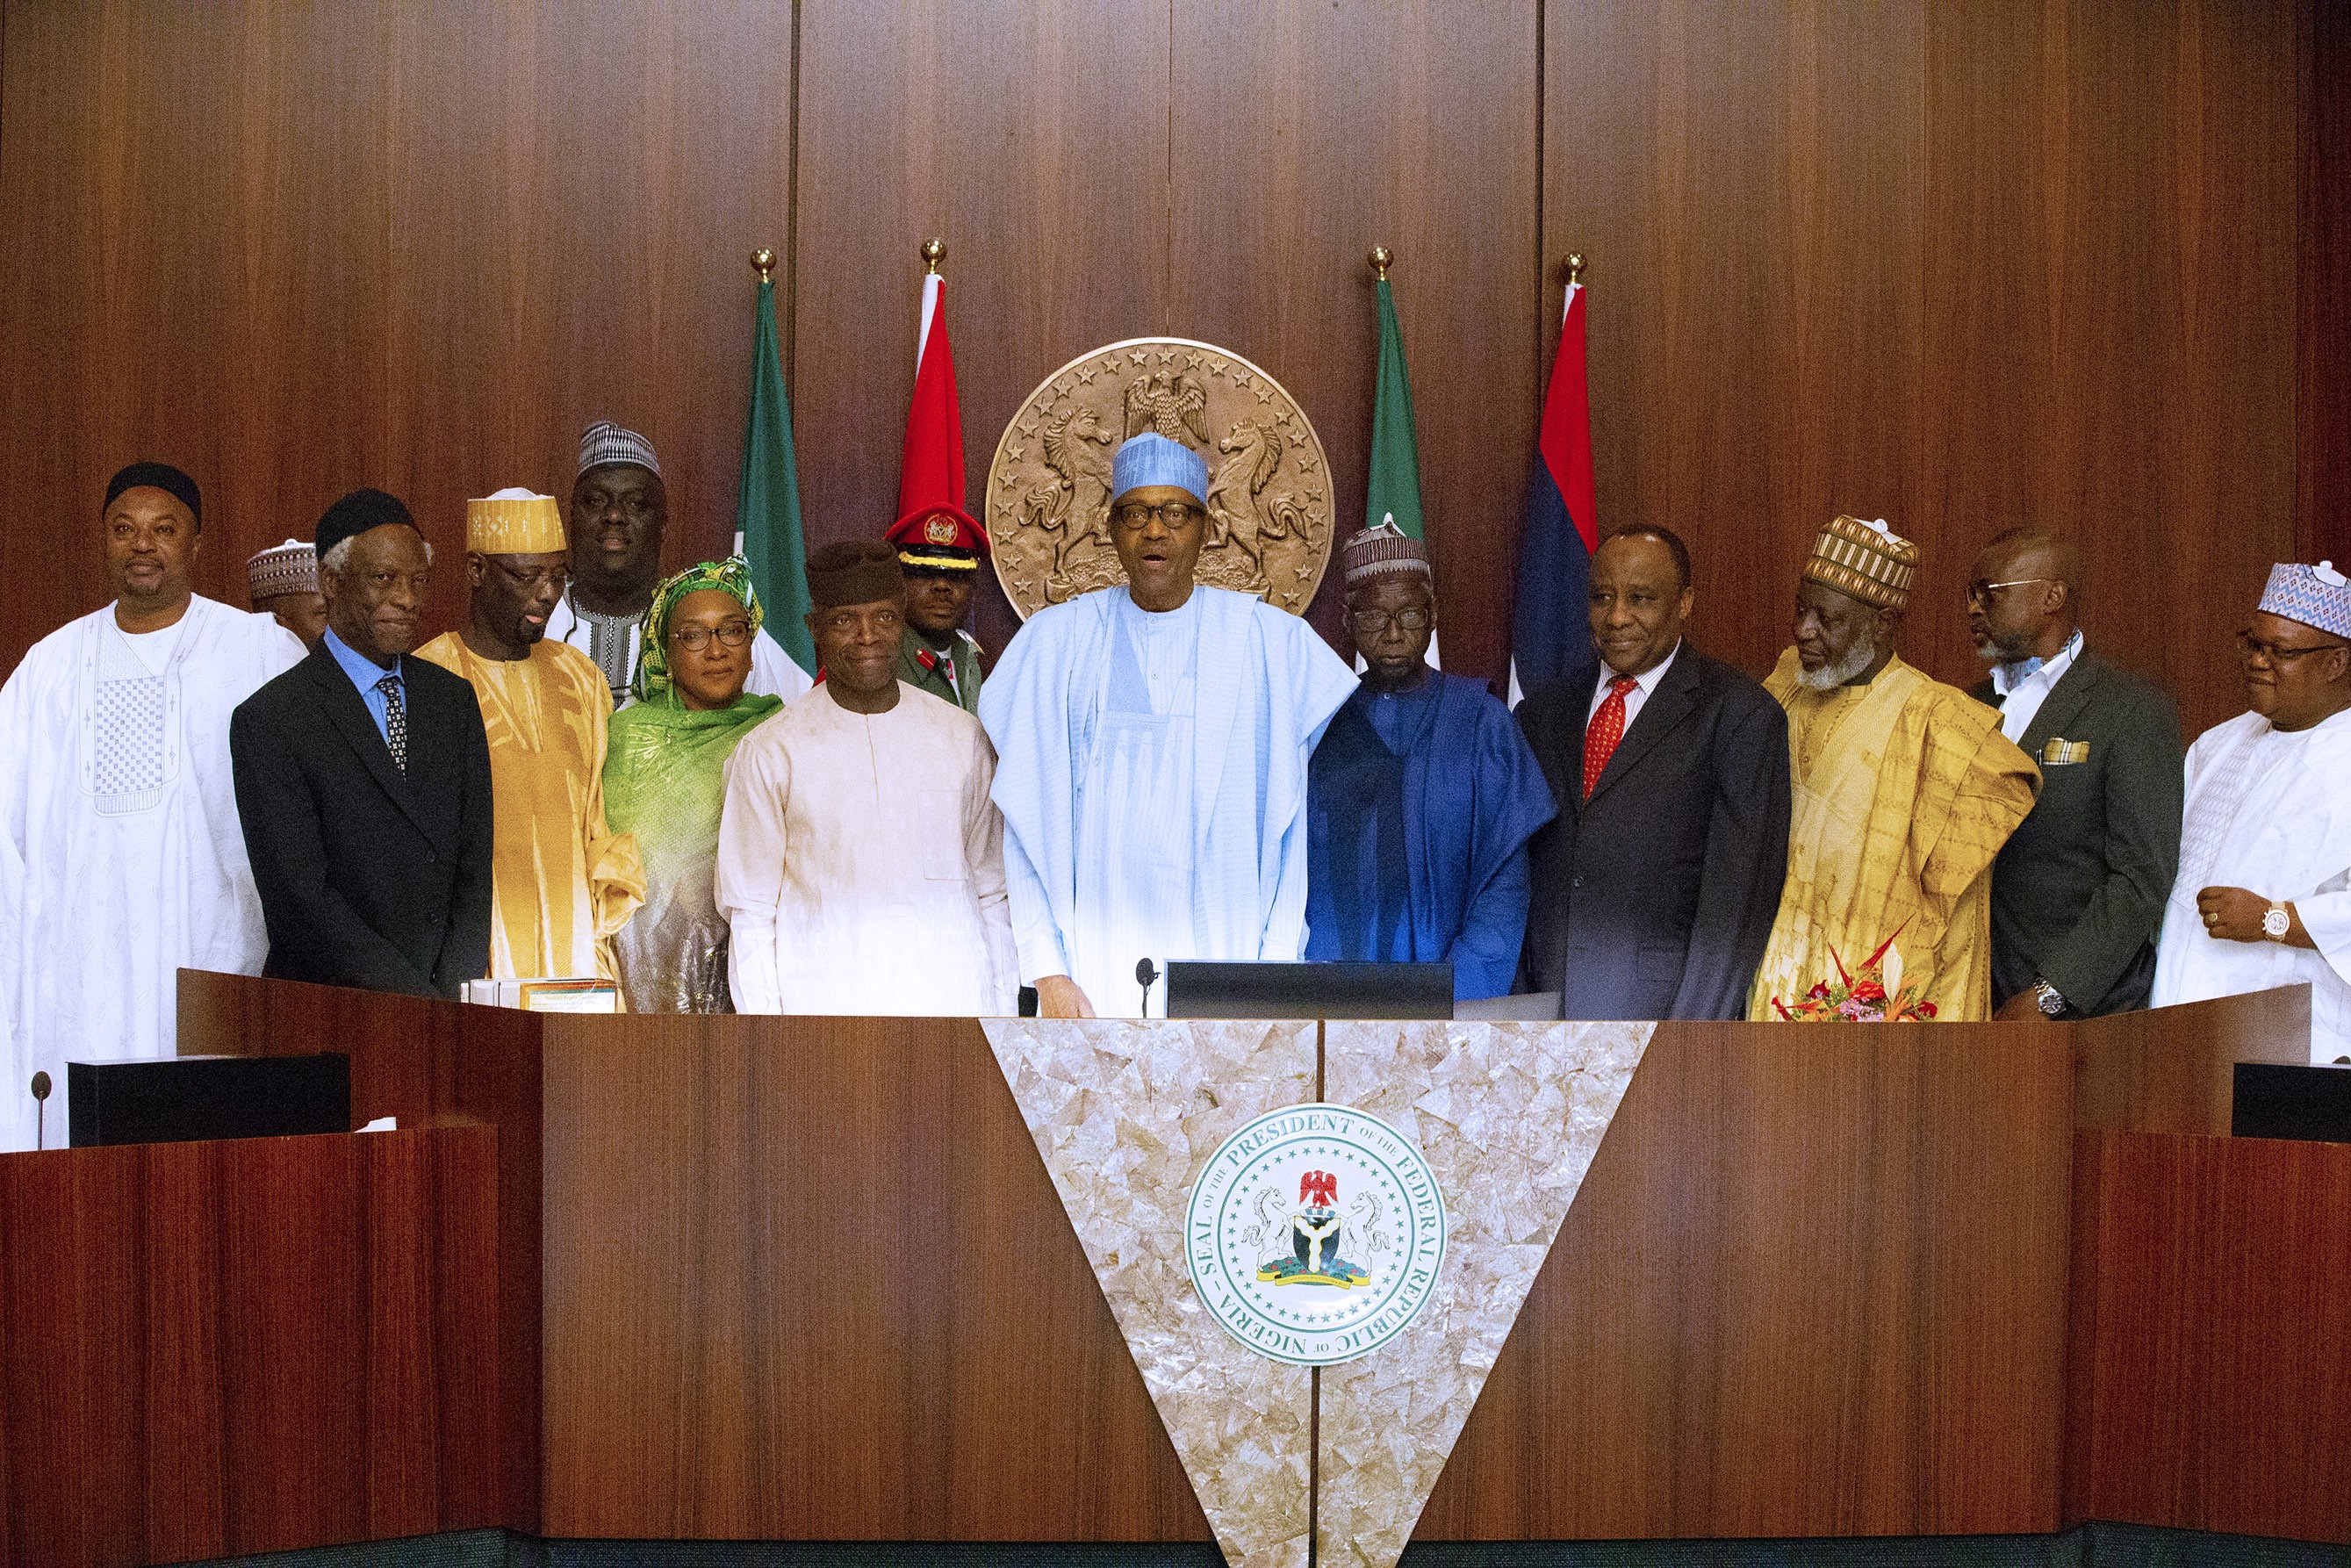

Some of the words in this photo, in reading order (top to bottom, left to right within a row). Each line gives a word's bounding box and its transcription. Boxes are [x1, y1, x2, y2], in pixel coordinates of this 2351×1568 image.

[1226, 1114, 1355, 1167] PRESIDENT
[1360, 1127, 1377, 1140] OF
[1377, 1137, 1398, 1156] THE
[1210, 1168, 1228, 1189] THE
[1204, 1193, 1214, 1208] OF
[1396, 1155, 1436, 1262] FEDERAL
[1196, 1216, 1217, 1276] SEAL
[1220, 1294, 1306, 1355] NIGERIA
[1335, 1268, 1429, 1352] REPUBLIC
[1312, 1342, 1329, 1353] OF
